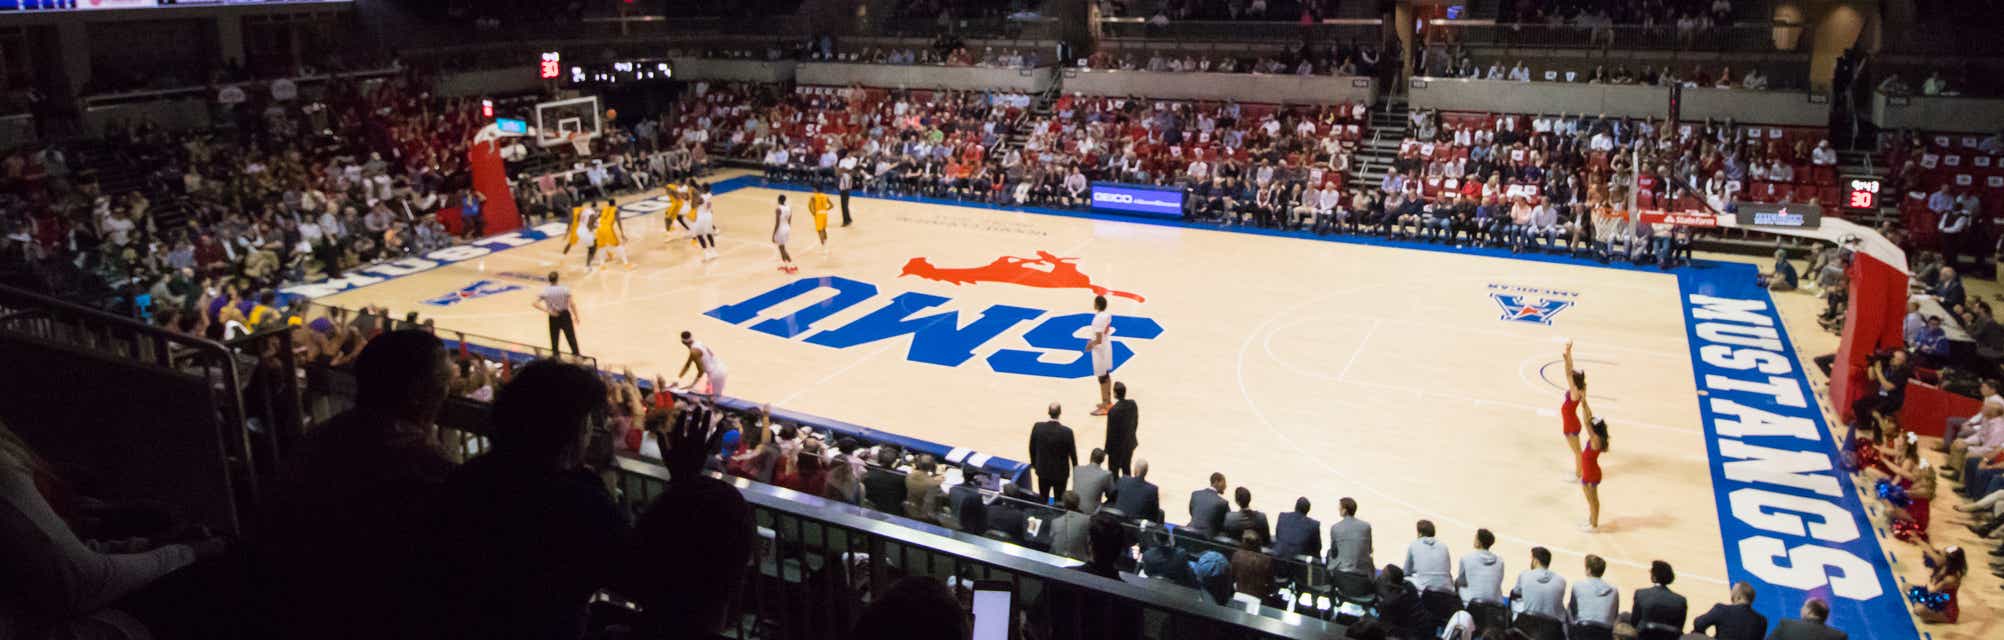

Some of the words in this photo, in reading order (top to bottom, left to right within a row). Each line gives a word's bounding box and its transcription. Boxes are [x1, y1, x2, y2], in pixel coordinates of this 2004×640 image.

[542, 61, 559, 78] 30
[1852, 180, 1879, 193] 9:43
[1851, 191, 1872, 208] 30
[702, 275, 1165, 379] SMU
[1689, 294, 1883, 600] MUSTANGS
